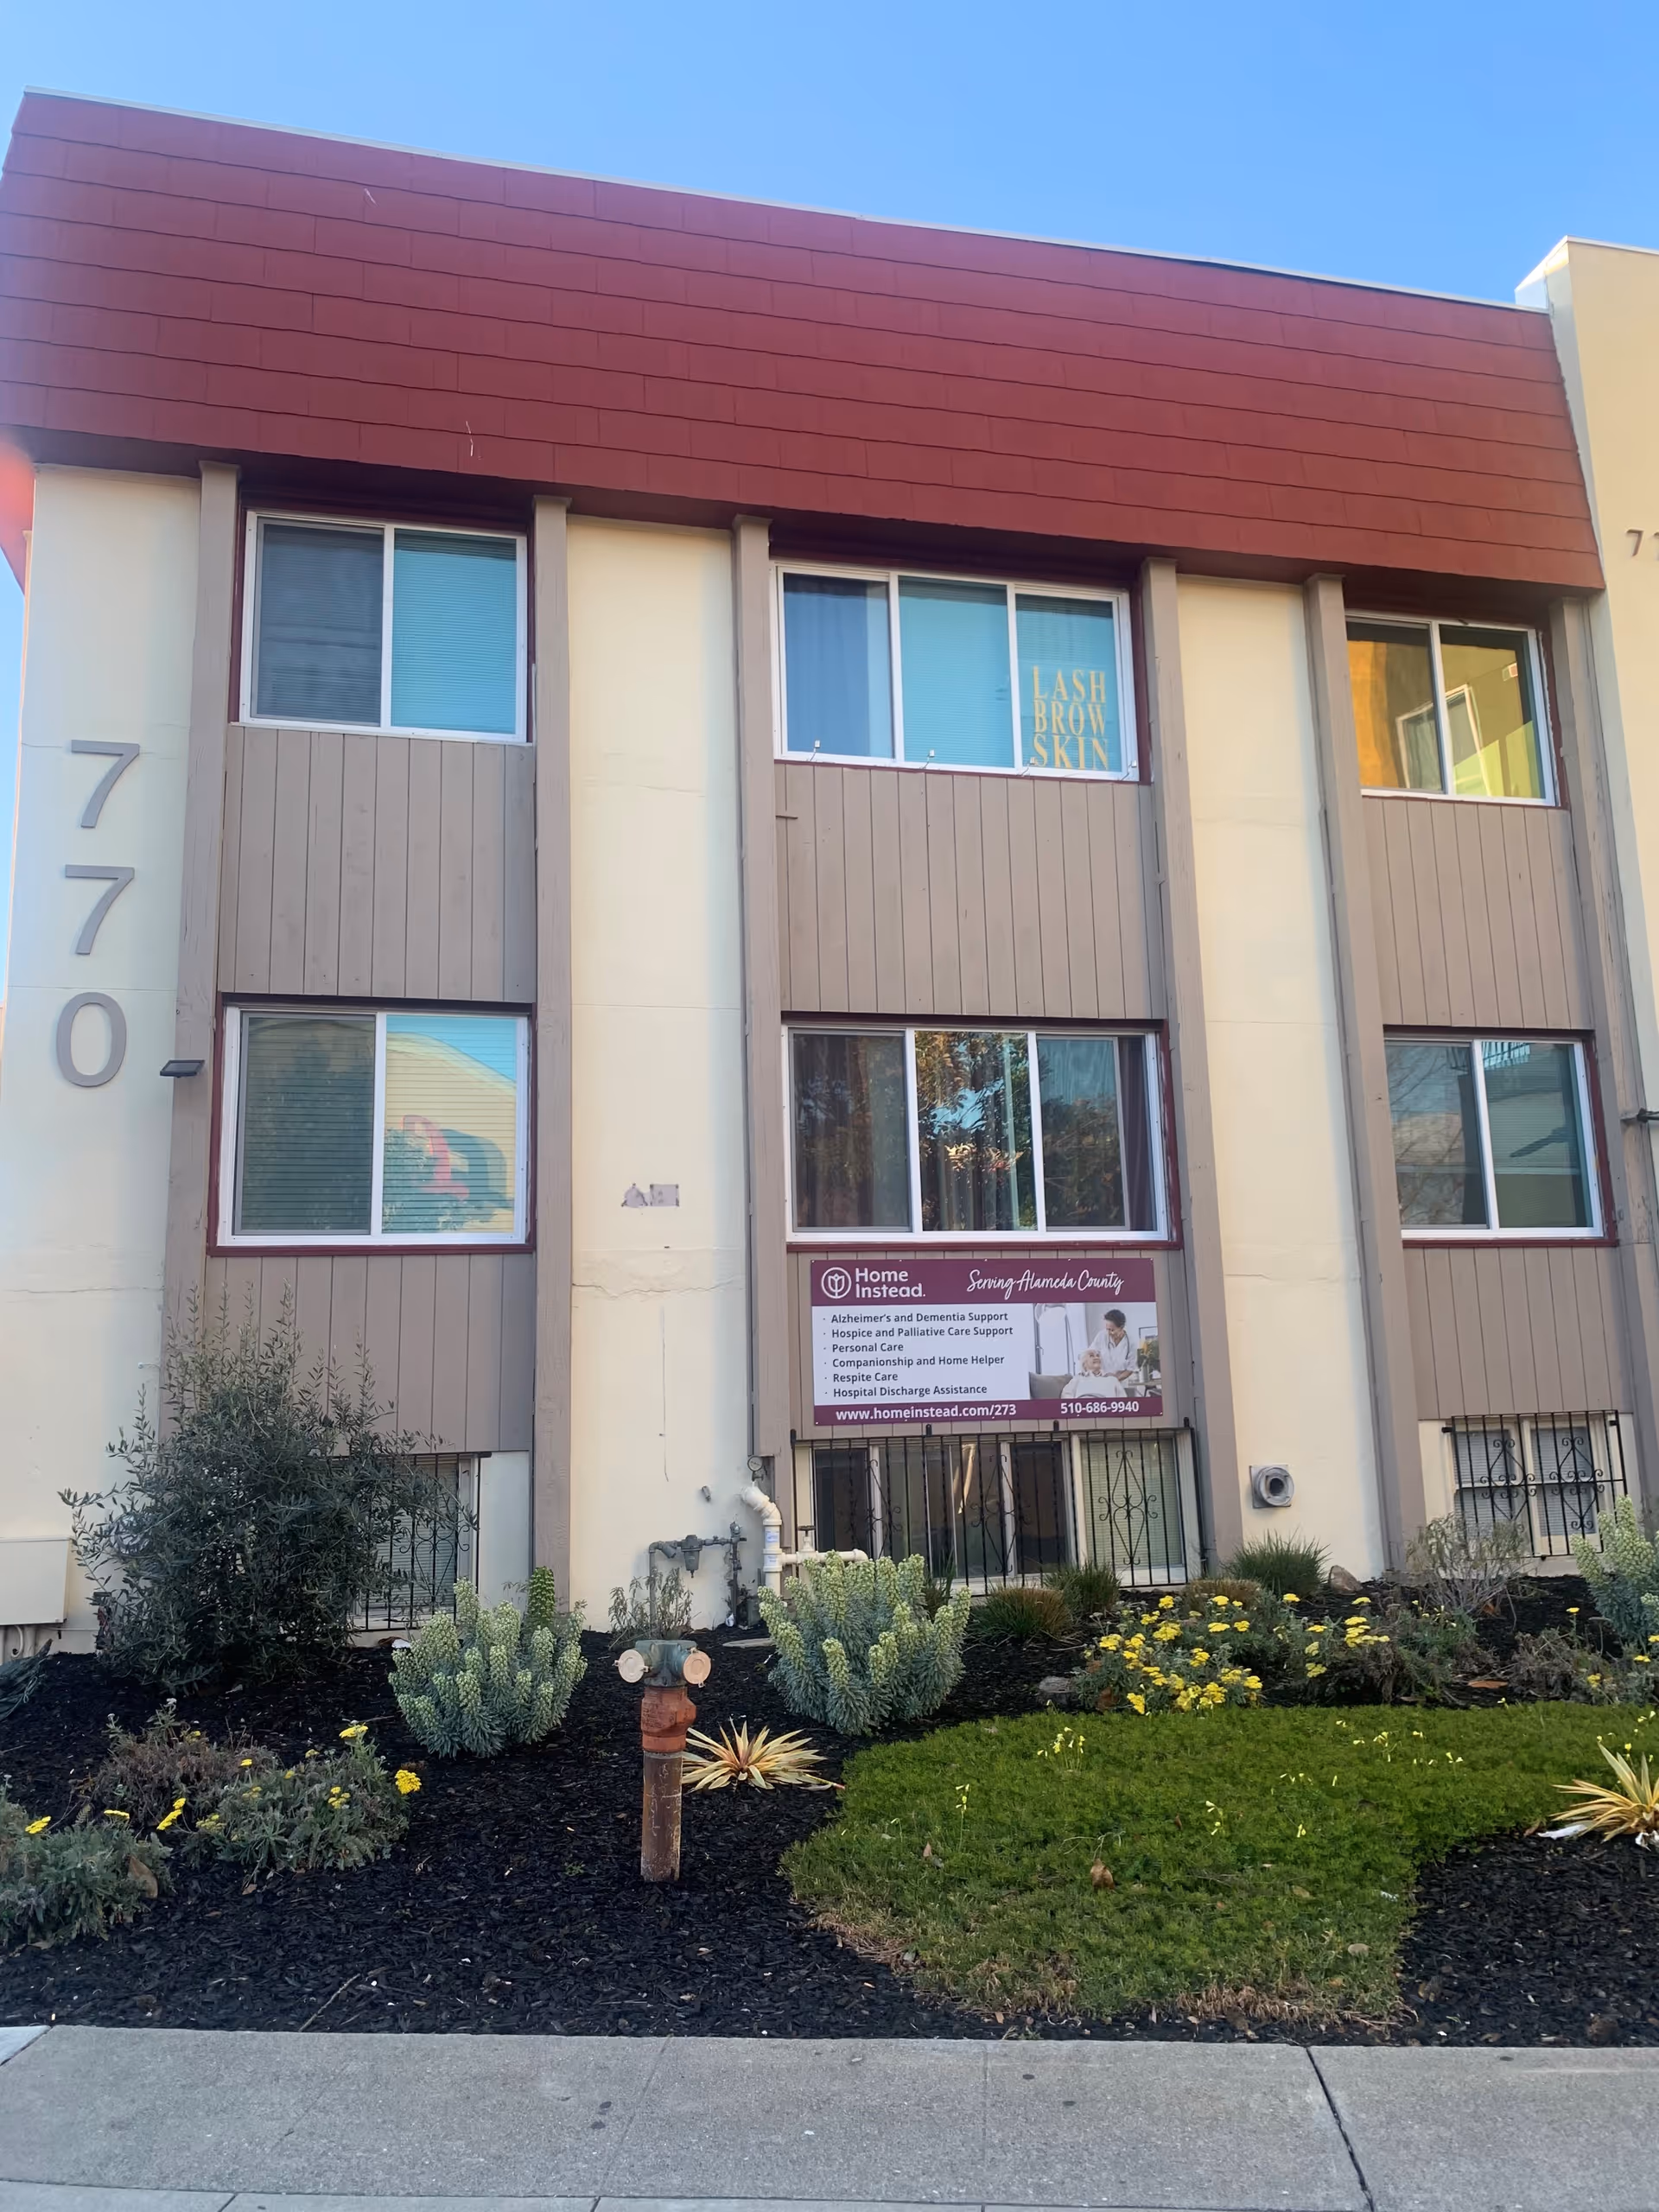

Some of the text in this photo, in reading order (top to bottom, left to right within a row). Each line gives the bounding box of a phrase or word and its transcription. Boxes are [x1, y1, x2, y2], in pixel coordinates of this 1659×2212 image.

[1033, 665, 1106, 703] LASH
[1033, 700, 1107, 736] BROW
[1033, 734, 1109, 771] SKIN
[855, 1268, 909, 1282] Home
[966, 1269, 1124, 1300] Serving Alameda County
[831, 1313, 1008, 1324] Alzheimer's and Dementia Support
[831, 1326, 1014, 1340] Hospice and Palliative Care Support
[832, 1343, 904, 1352] Personal Care
[832, 1355, 1005, 1369] Companionship and Home Helper
[833, 1372, 899, 1384] Respite Care
[833, 1384, 988, 1399] Hospital Discharge Assistance
[835, 1401, 1140, 1421] www.homeinstead.com/273 510-686-9940
